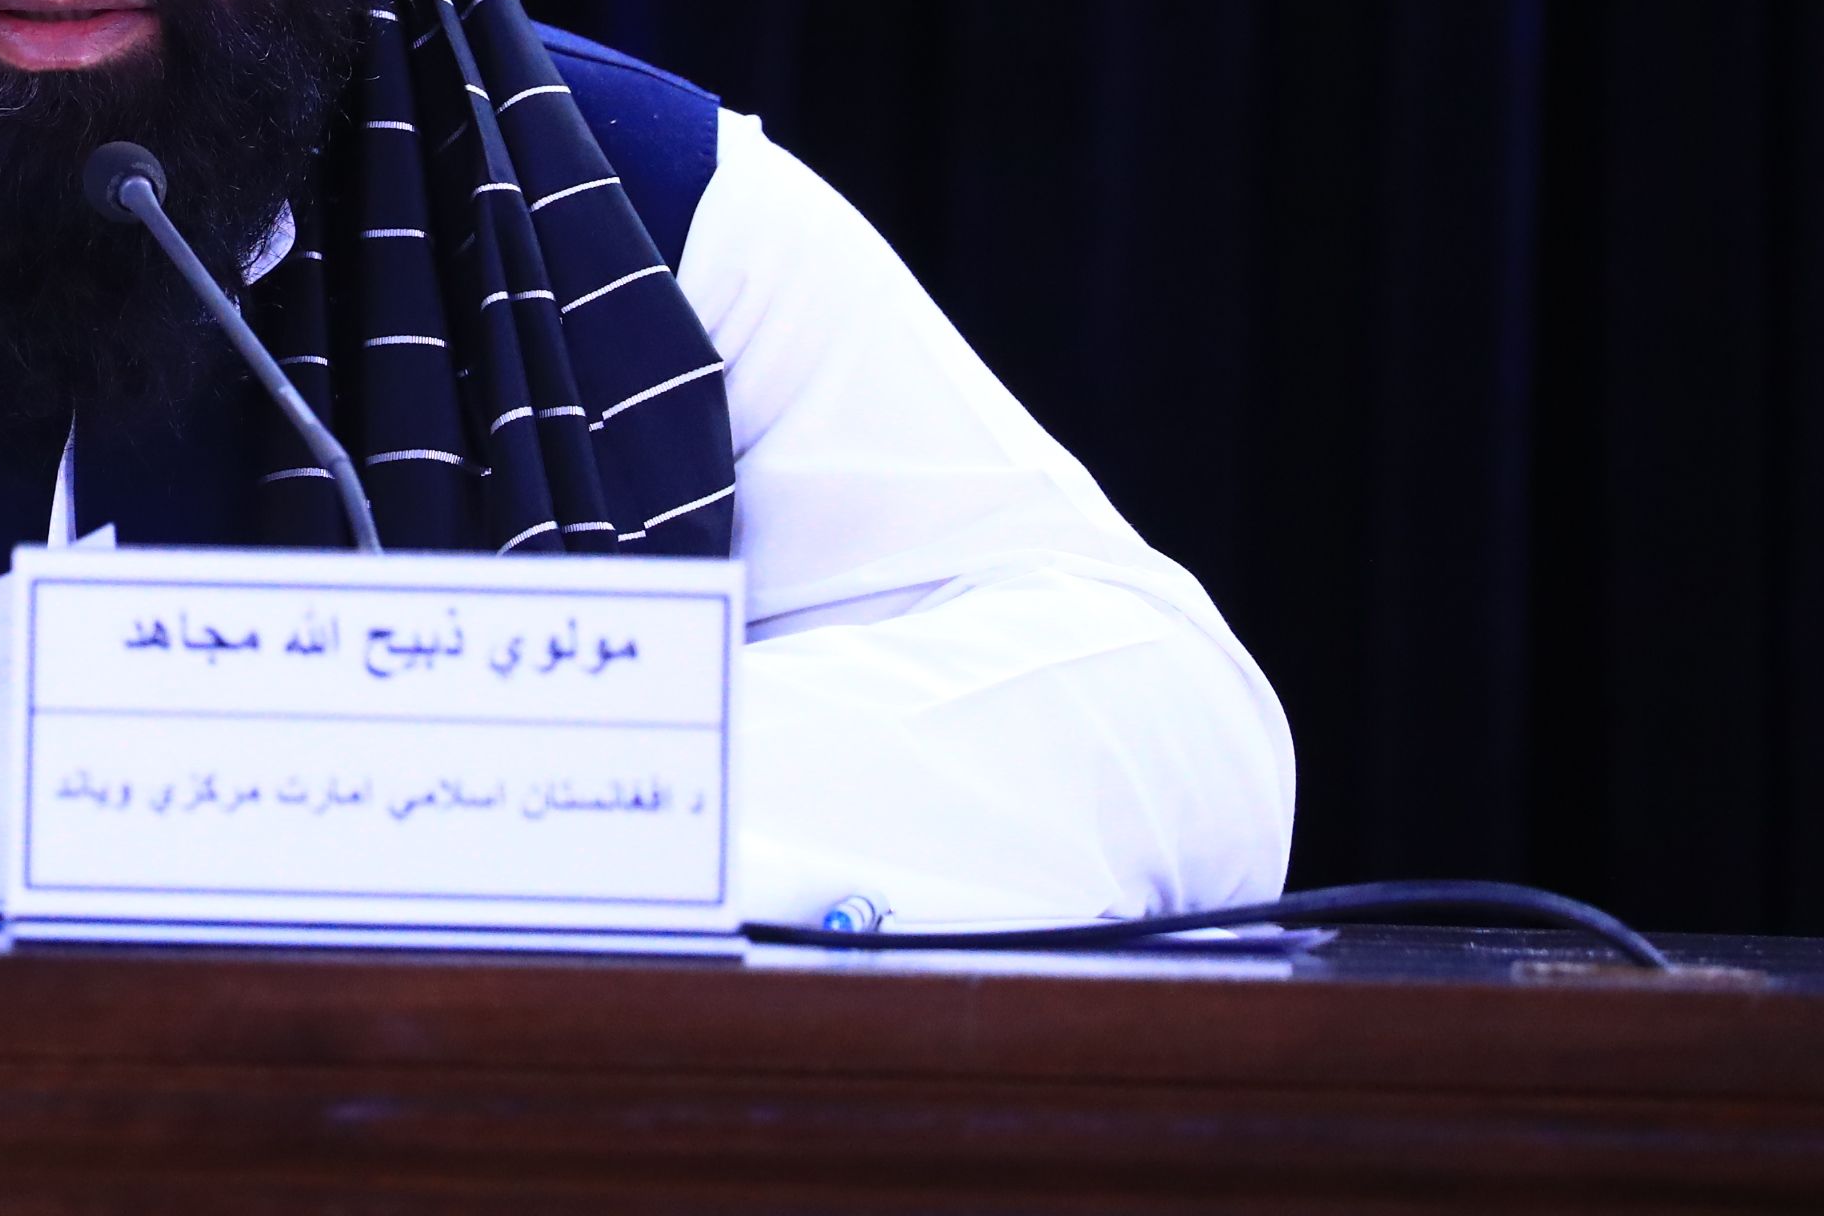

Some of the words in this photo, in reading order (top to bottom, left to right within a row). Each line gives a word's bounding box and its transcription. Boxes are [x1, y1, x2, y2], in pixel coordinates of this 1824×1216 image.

[121, 612, 264, 667] مجاهد
[282, 612, 342, 659] الله
[362, 607, 466, 682] ذبيح
